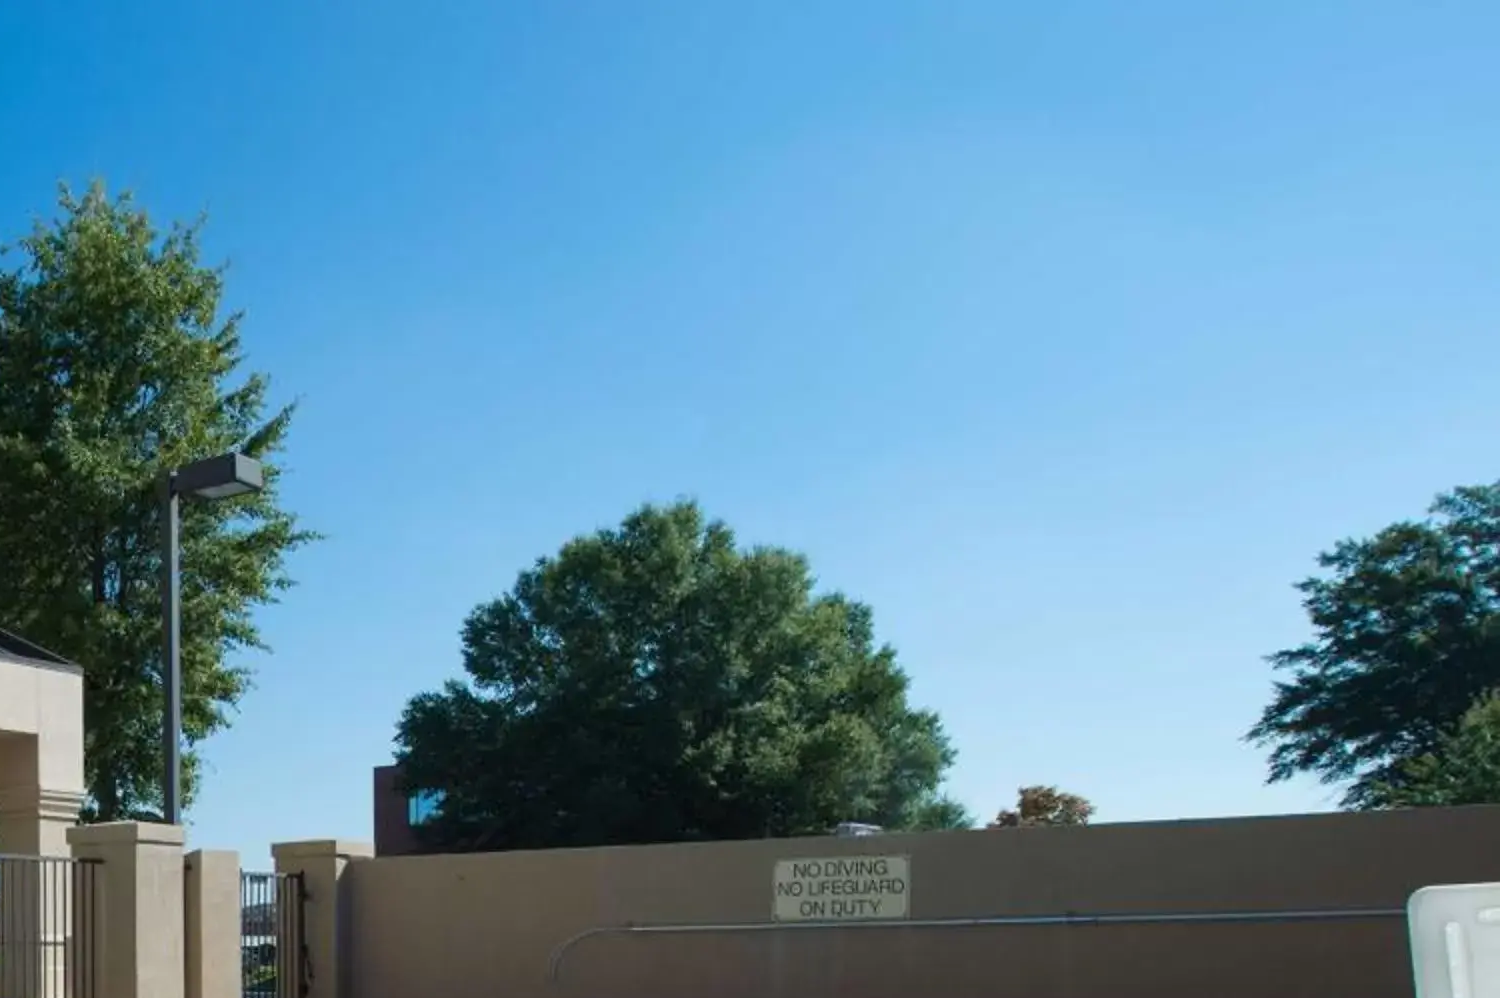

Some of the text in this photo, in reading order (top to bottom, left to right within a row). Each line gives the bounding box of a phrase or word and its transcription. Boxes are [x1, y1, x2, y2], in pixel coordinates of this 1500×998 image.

[793, 859, 888, 878] NO DIVING
[778, 878, 905, 897] NO LIFEGUARD
[800, 899, 882, 917] ON DUTY
